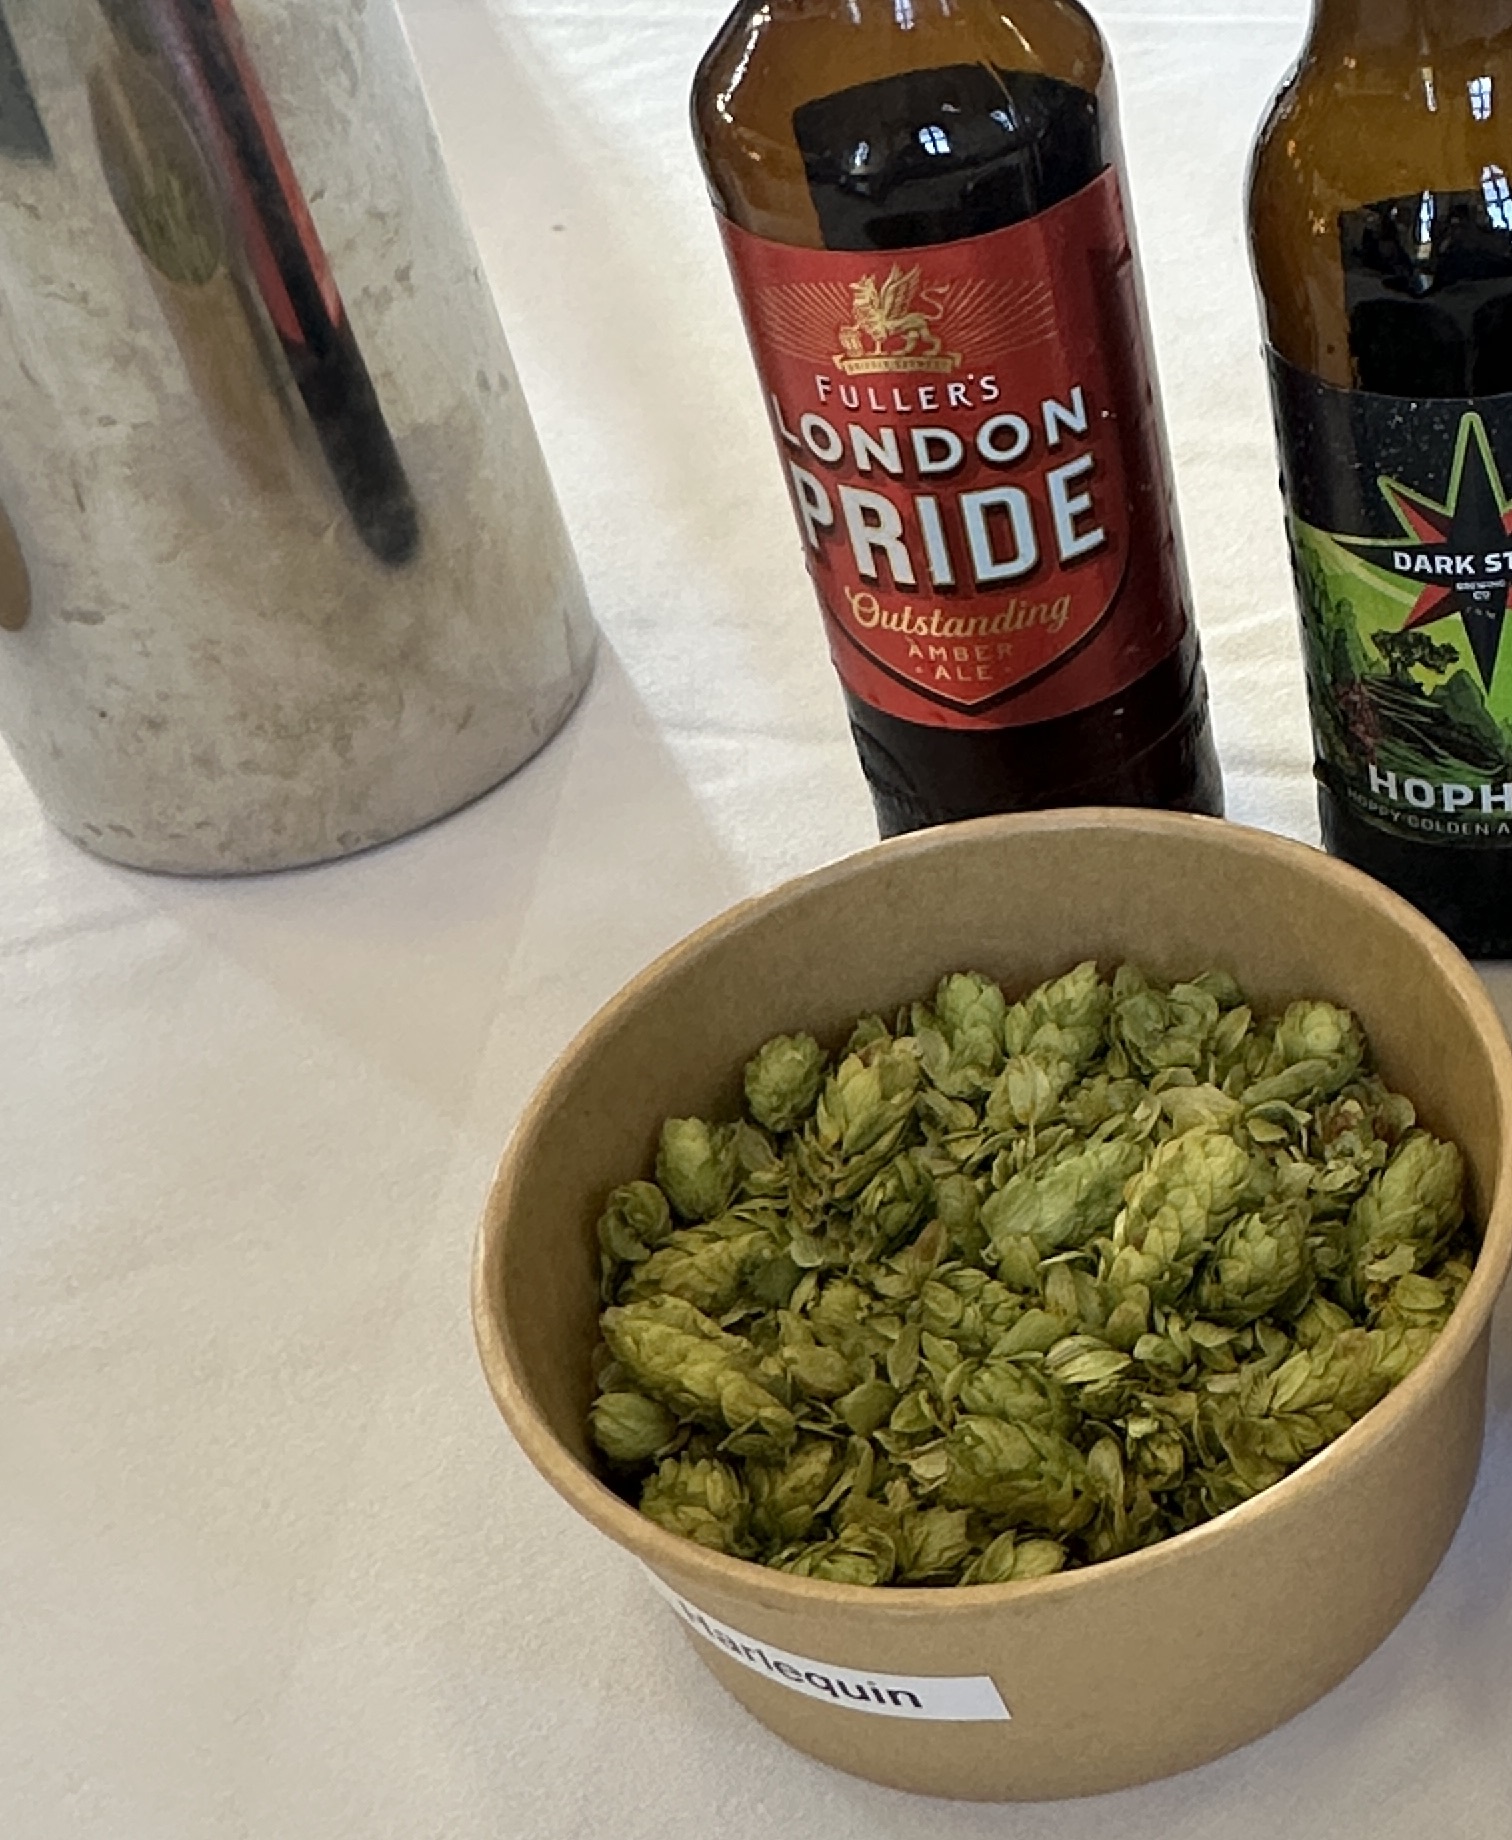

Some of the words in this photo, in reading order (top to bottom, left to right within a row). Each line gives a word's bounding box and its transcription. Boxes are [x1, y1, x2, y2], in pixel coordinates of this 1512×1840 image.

[815, 373, 1000, 412] FULLER'S
[772, 385, 1089, 474] LONDON
[789, 452, 1106, 586] PRIDE
[1393, 551, 1475, 575] DARK
[845, 585, 1072, 637] Outstanding
[907, 640, 1013, 662] AMBER
[934, 664, 993, 681] ALE
[1407, 814, 1490, 835] GOLDEN
[679, 1600, 923, 1708] Harlequin
